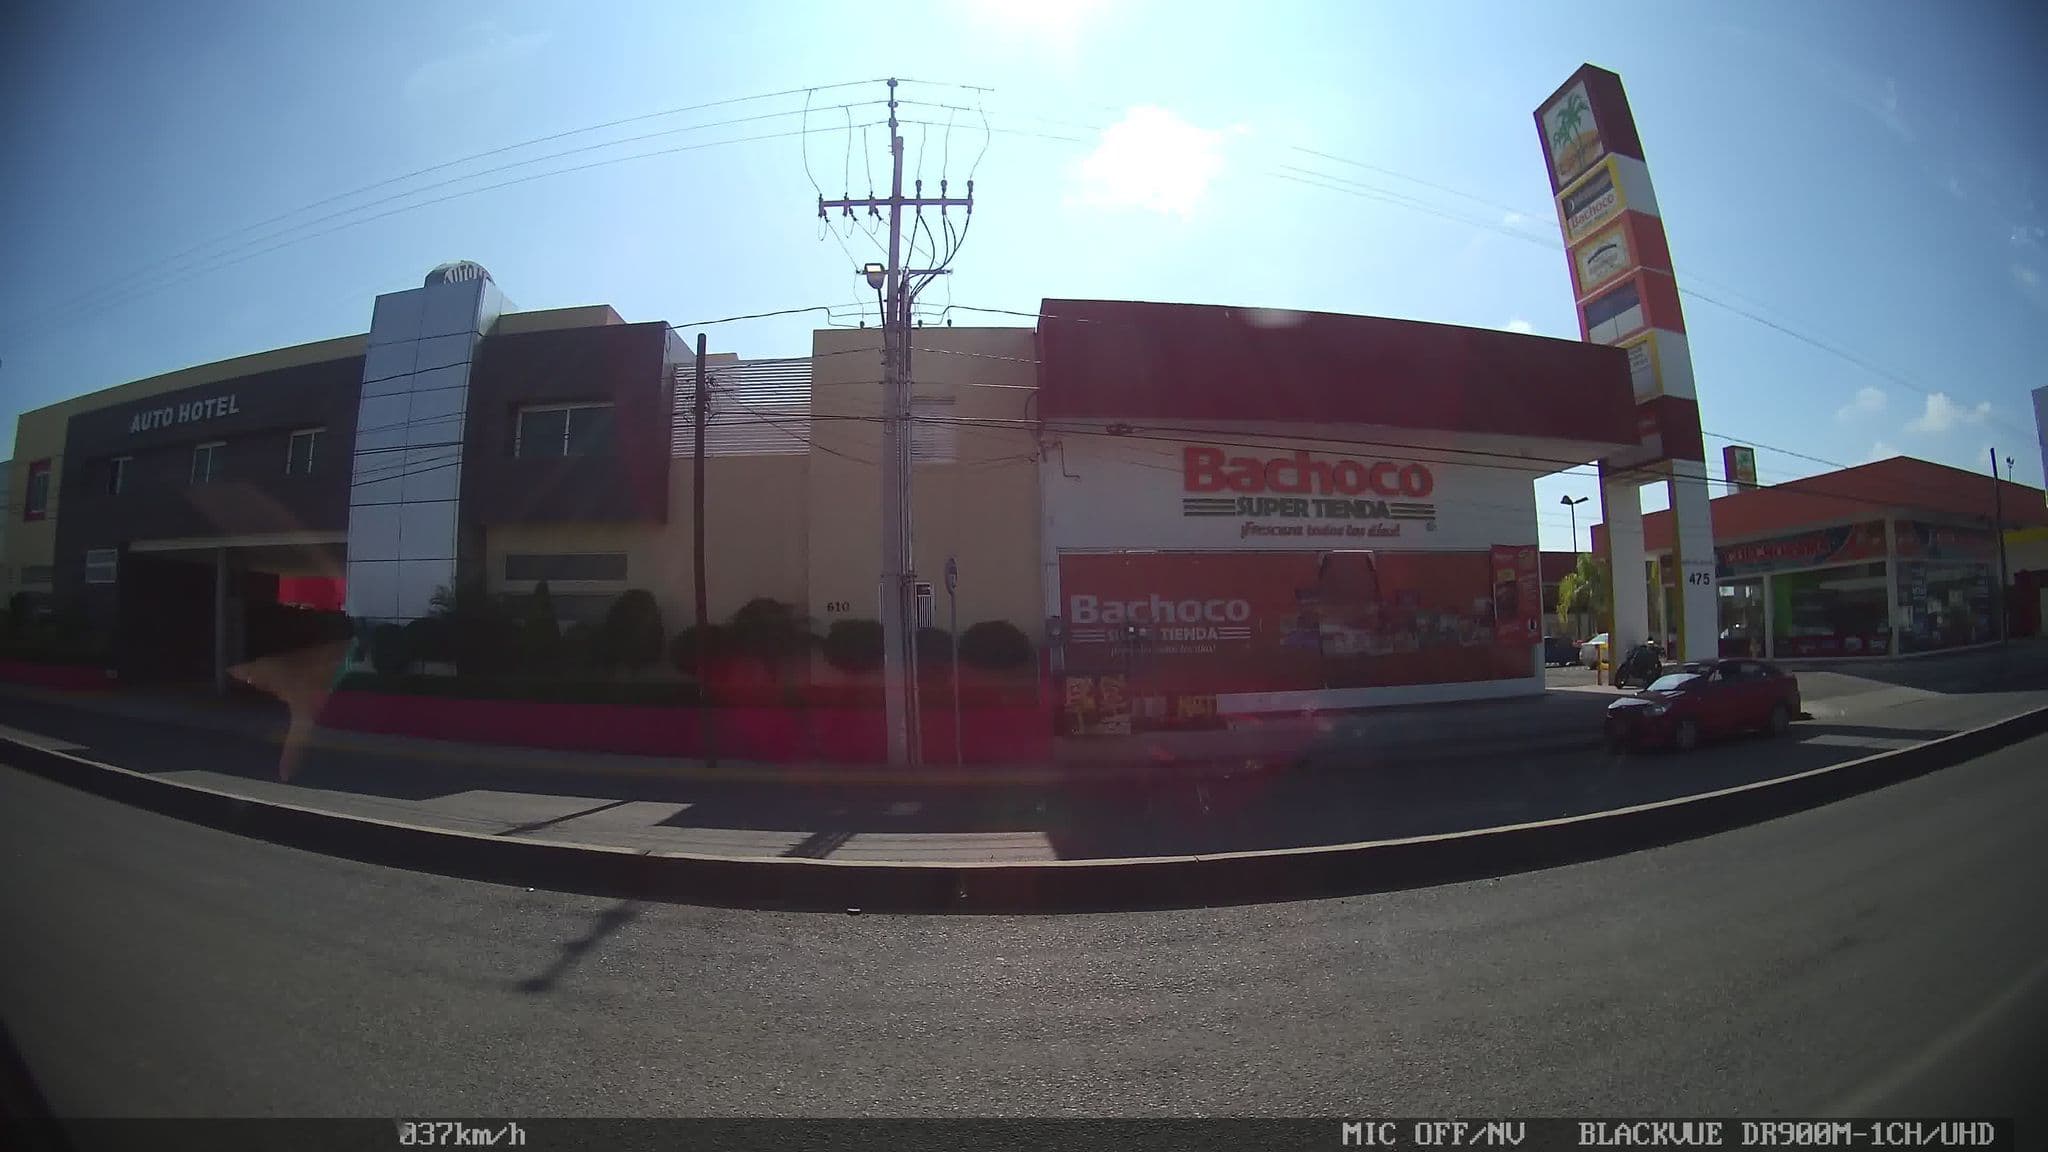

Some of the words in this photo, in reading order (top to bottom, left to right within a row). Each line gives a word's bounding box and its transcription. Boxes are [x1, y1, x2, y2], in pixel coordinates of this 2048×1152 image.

[444, 264, 478, 285] AUTO
[129, 408, 174, 433] AUTO
[178, 394, 240, 423] HOTEL
[1184, 446, 1433, 497] Bachoco
[1236, 497, 1310, 518] SUPER
[1312, 499, 1392, 519] TIENDA
[1689, 572, 1710, 586] 475
[827, 602, 850, 613] 610
[1070, 593, 1251, 623] Bachoco
[1160, 627, 1218, 641] TIENDA
